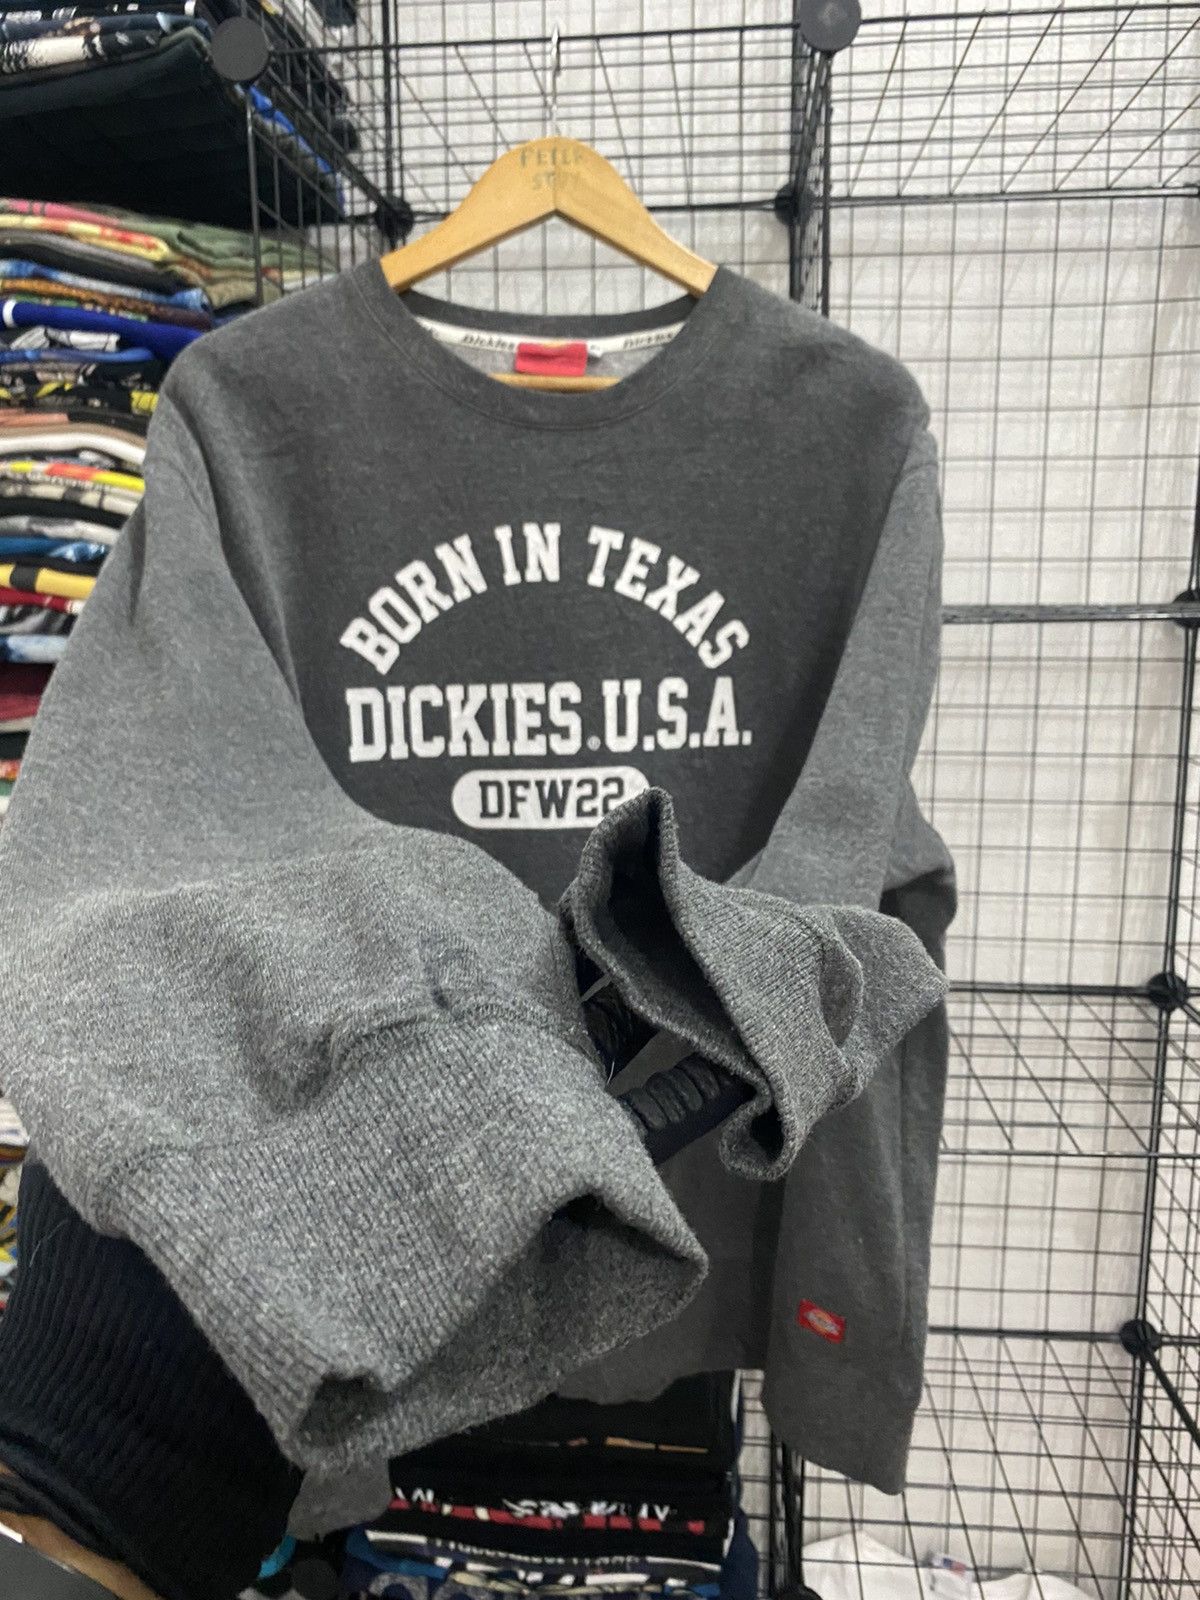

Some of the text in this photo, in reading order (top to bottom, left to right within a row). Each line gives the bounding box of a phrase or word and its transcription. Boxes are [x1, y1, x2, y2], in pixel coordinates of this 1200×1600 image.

[340, 523, 750, 675] BORN IN TEXAS
[479, 777, 624, 818] DFW22
